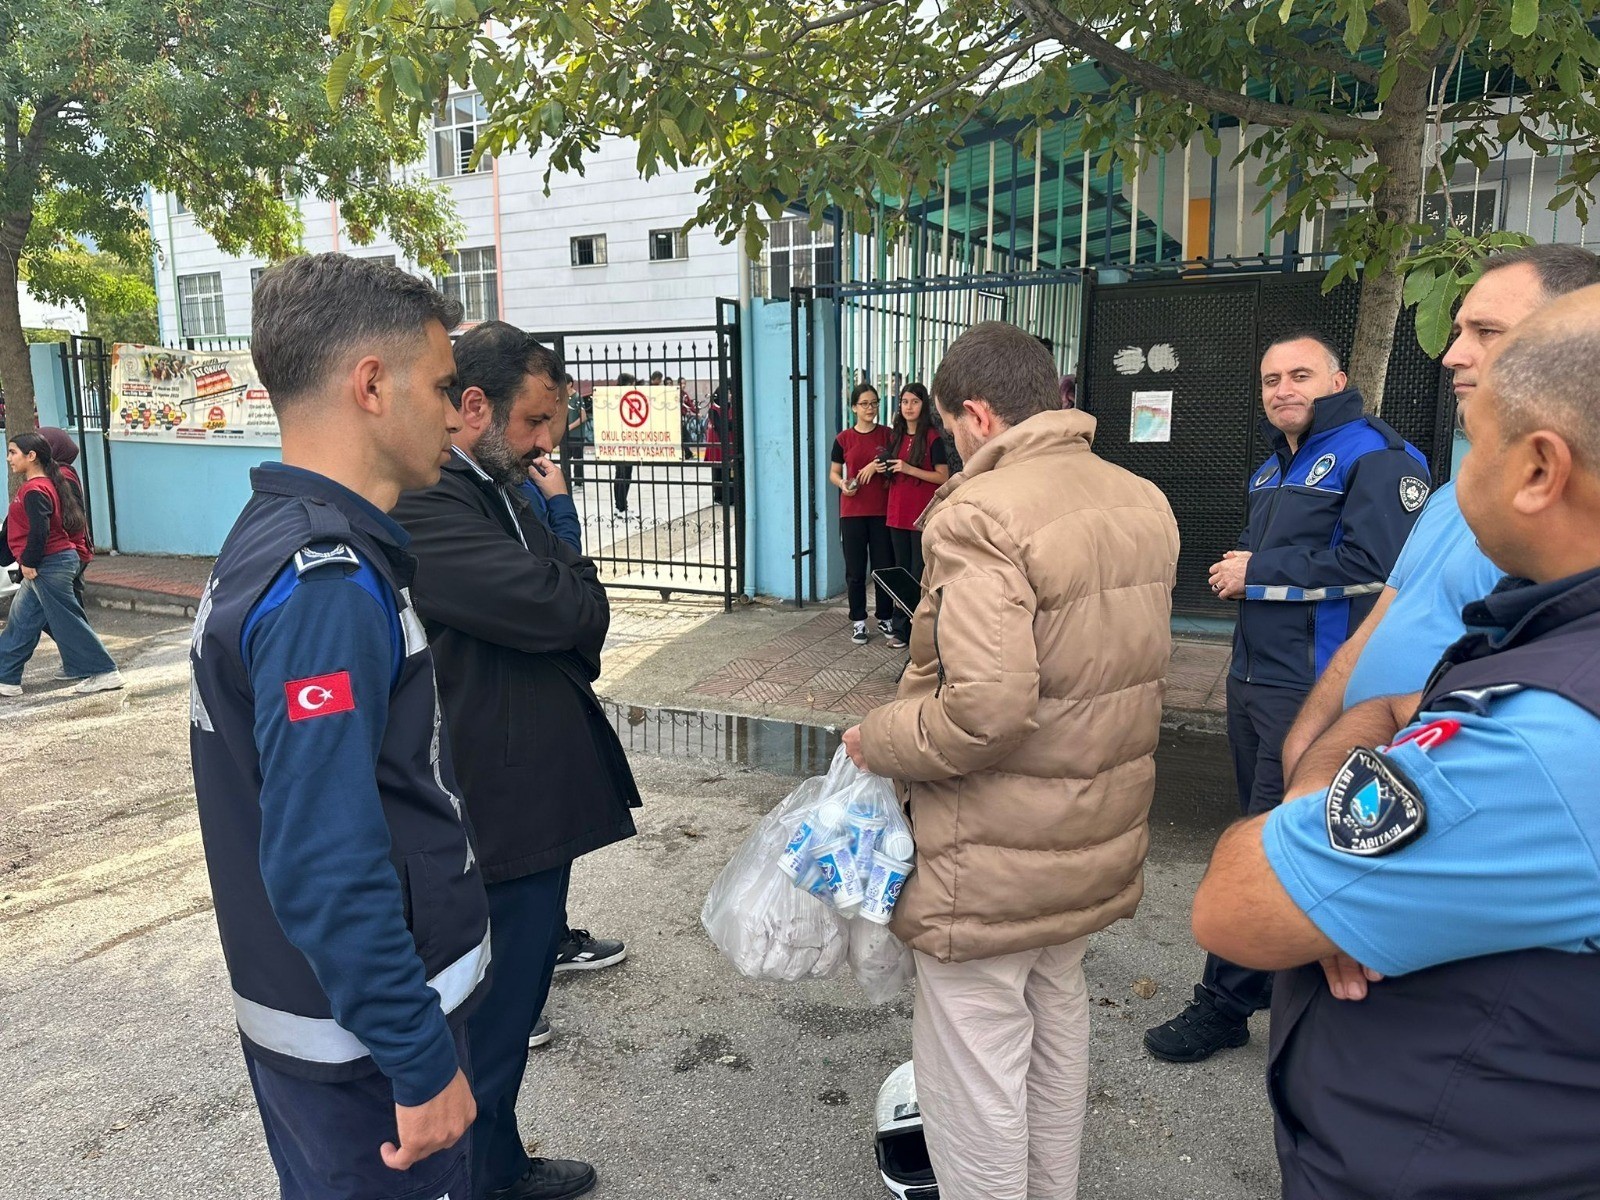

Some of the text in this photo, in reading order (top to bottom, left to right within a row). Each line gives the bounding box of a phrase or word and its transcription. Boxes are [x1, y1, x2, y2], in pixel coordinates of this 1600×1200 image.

[601, 430, 619, 441] OKUL
[640, 431, 671, 445] ÇIKIŞIDIR
[599, 445, 617, 456] PARK
[618, 446, 641, 457] ETMEK
[1359, 753, 1417, 818] YUNUSEMRE
[1351, 824, 1402, 849] ZABITASI
